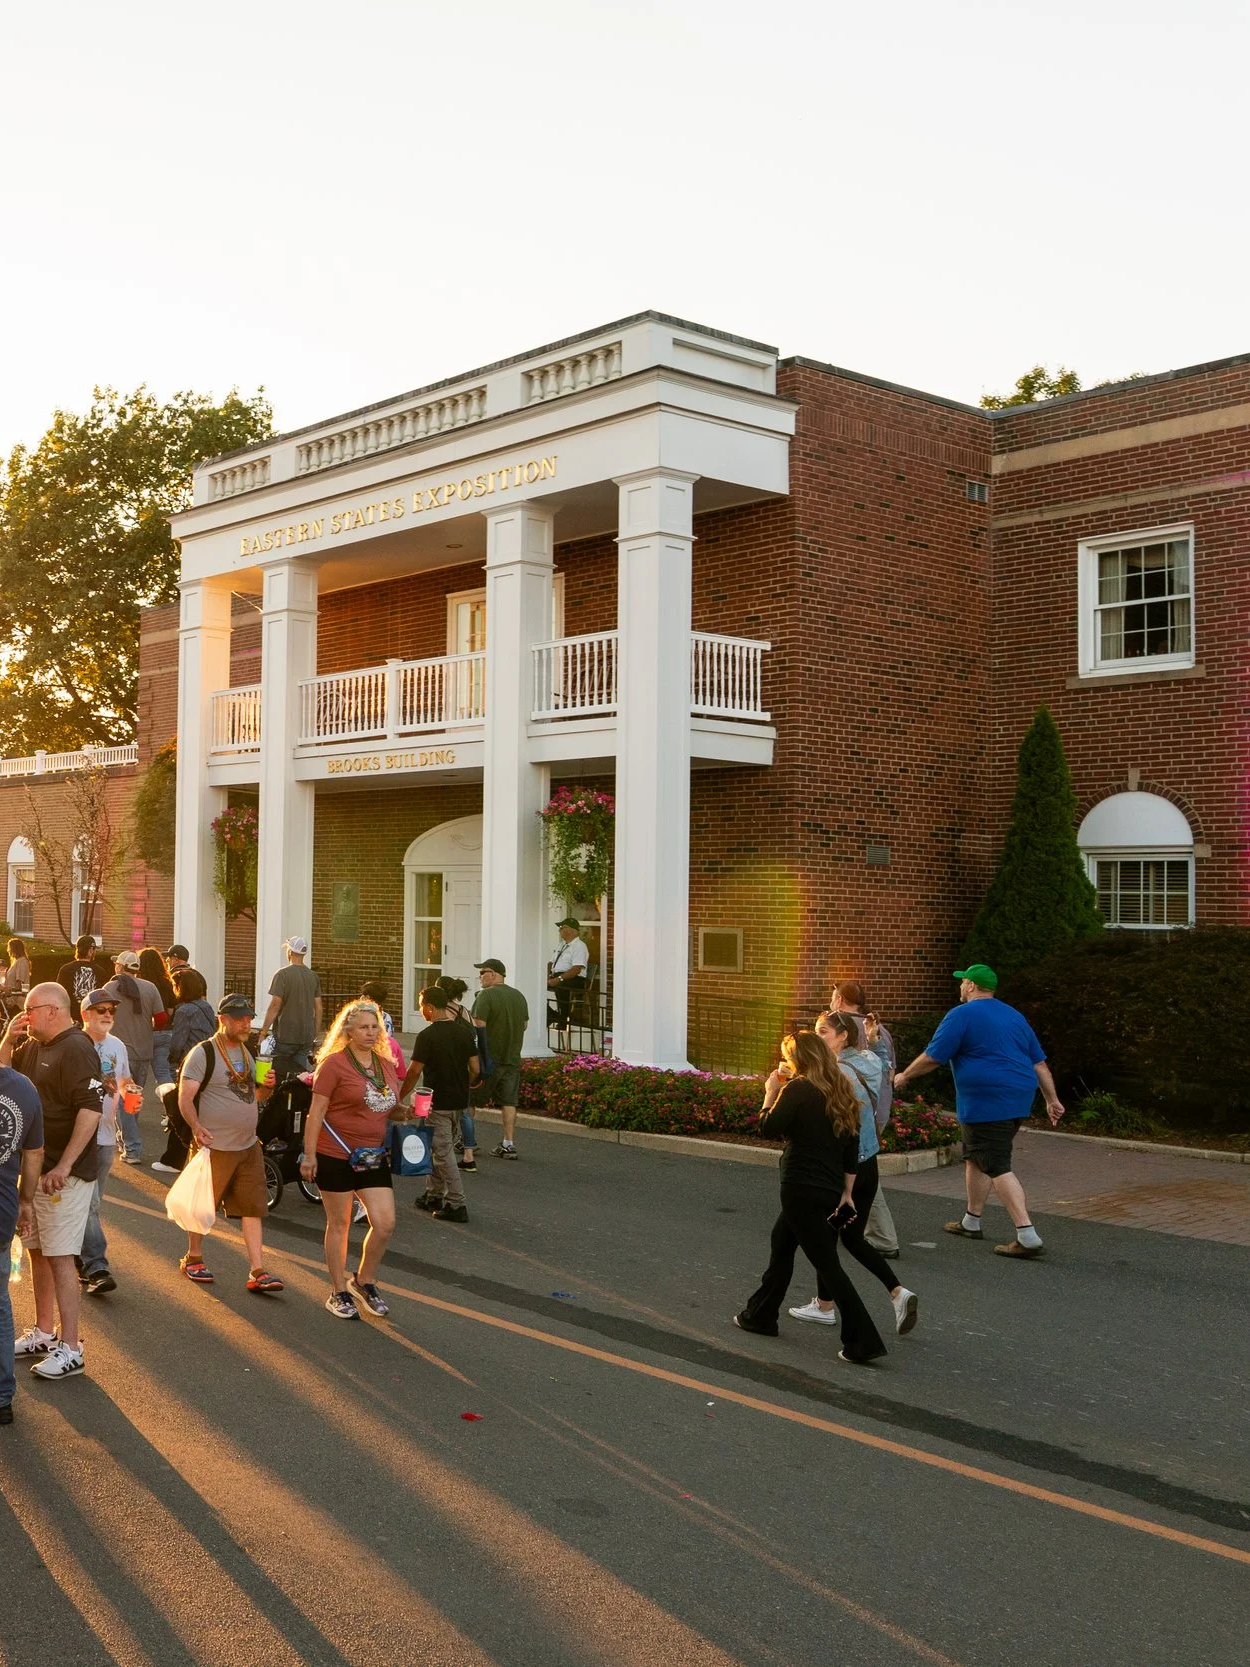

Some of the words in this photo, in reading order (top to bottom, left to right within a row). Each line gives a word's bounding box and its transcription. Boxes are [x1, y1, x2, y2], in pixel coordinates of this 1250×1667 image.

[239, 517, 325, 557] EASTERN
[330, 497, 406, 535] STATES
[411, 455, 558, 513] EXPOSITION
[326, 756, 381, 774] BROOKS
[385, 750, 457, 769] BUILDING
[0, 1109, 13, 1135] SKYWAY
